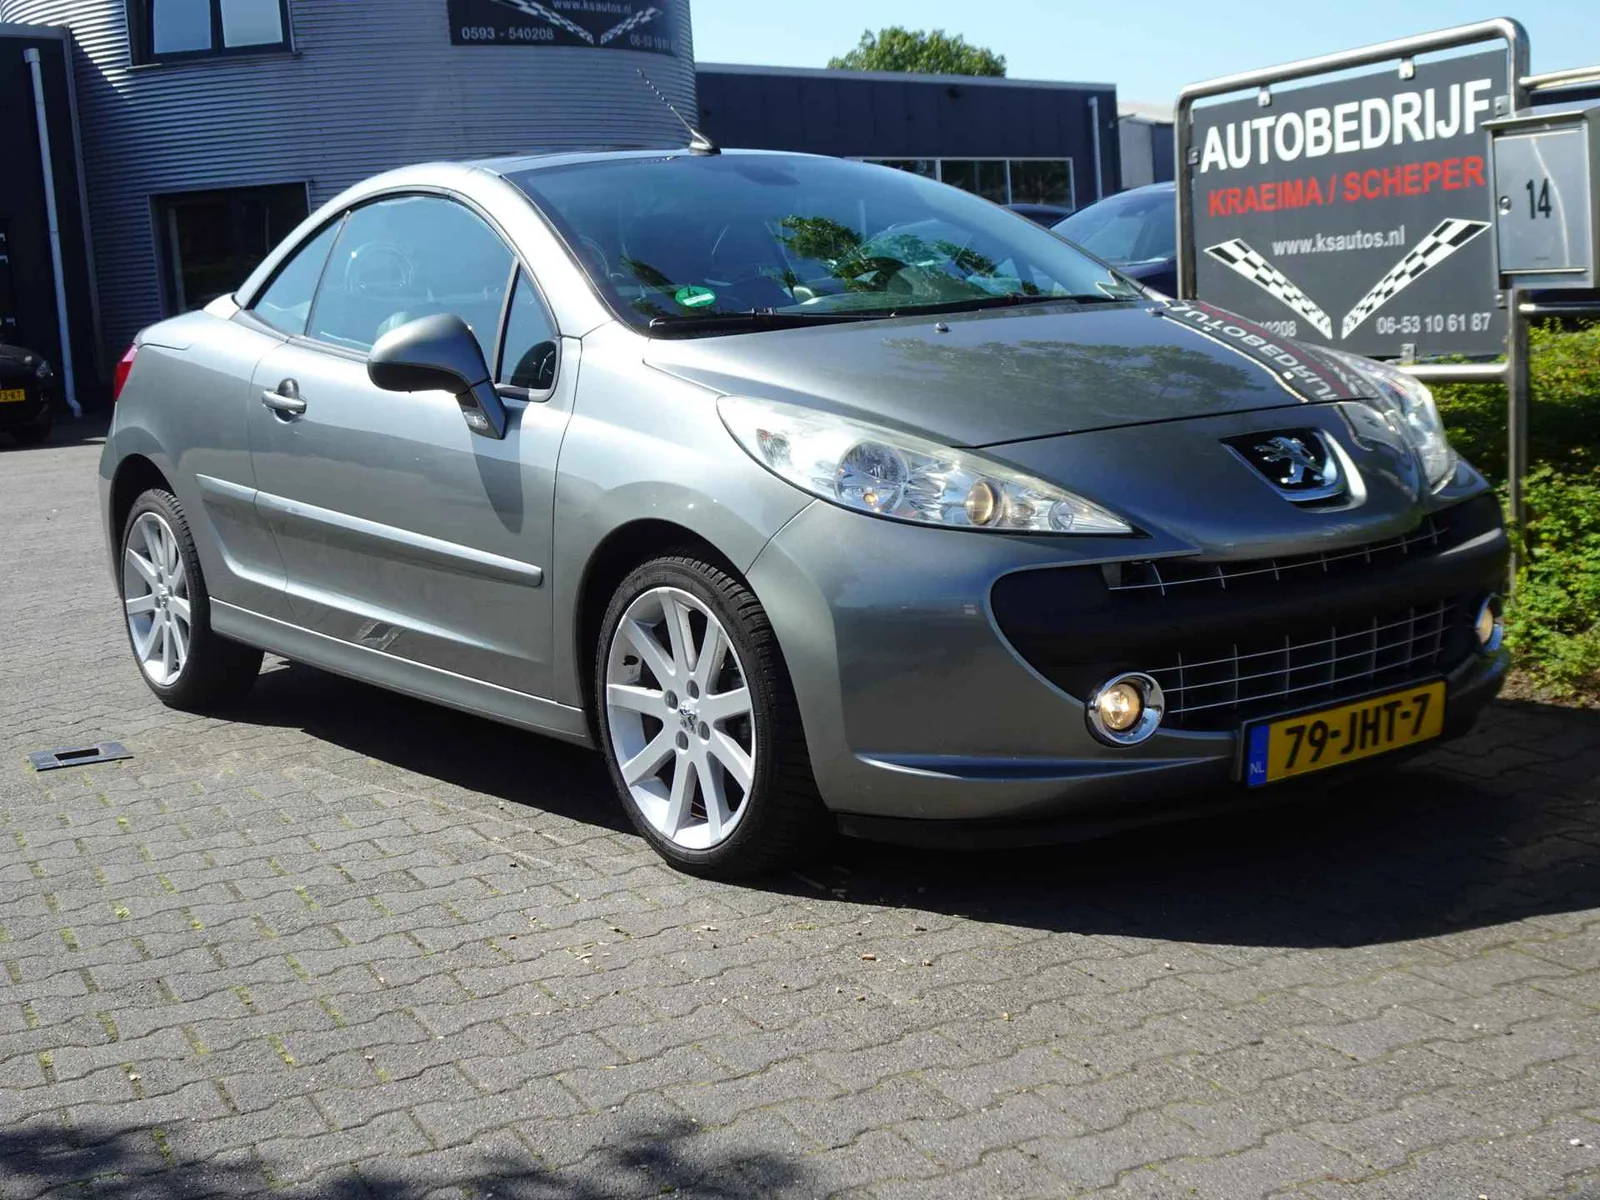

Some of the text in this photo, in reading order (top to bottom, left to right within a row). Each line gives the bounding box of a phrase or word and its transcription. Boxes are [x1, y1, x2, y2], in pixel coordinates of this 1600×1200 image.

[461, 27, 495, 40] 0593
[508, 27, 554, 40] 540208
[1200, 78, 1492, 173] AUTOBEDRIJF
[1208, 155, 1487, 217] KRAEIMA / SCHEPER
[1526, 178, 1553, 220] 14
[1272, 225, 1406, 256] www.ksautos.nl
[1376, 311, 1492, 336] 06-53 10 61 87
[1285, 693, 1432, 769] 79-JHT-7
[1250, 762, 1265, 774] NL
